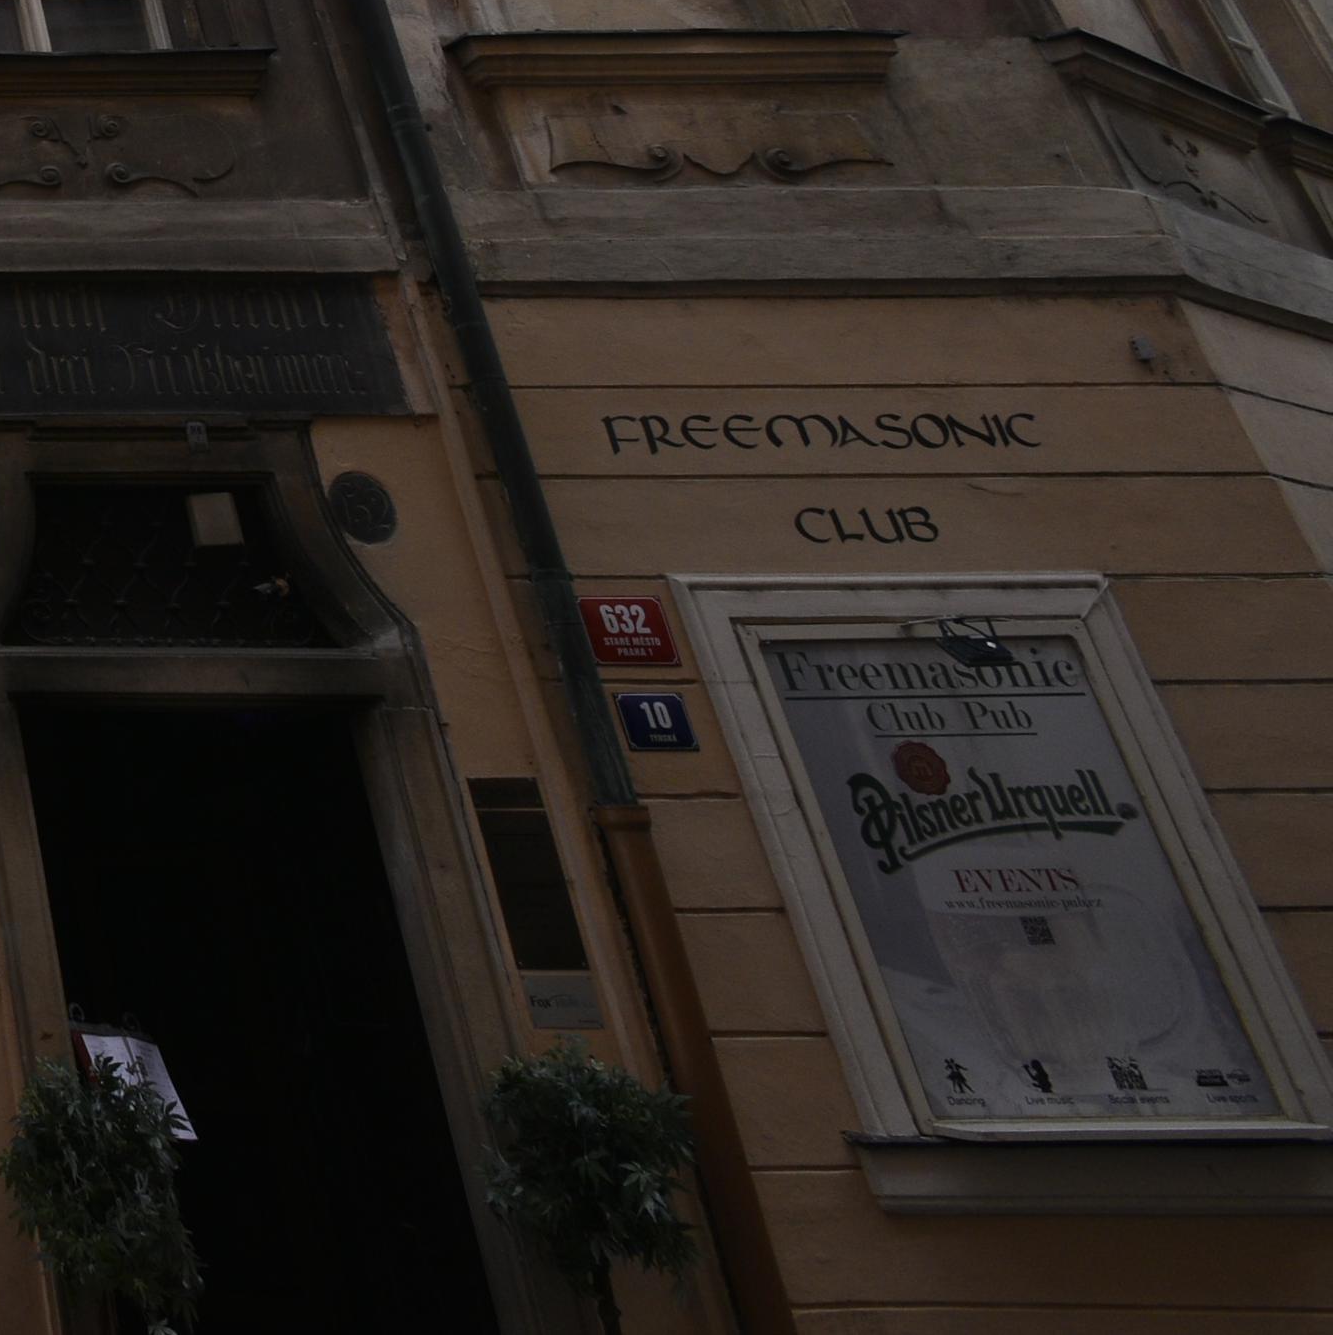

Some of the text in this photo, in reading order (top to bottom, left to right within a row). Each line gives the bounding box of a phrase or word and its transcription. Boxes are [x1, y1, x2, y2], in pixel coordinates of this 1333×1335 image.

[601, 413, 1042, 455] FREEMASONIC
[793, 506, 939, 544] CLUB
[599, 604, 651, 634] 632
[773, 648, 1081, 691] Freemasonic
[639, 701, 673, 729] 10
[866, 700, 1033, 732] Club Pub
[846, 766, 1117, 874] Pilsner Urquell
[950, 868, 1084, 893] EVENTS
